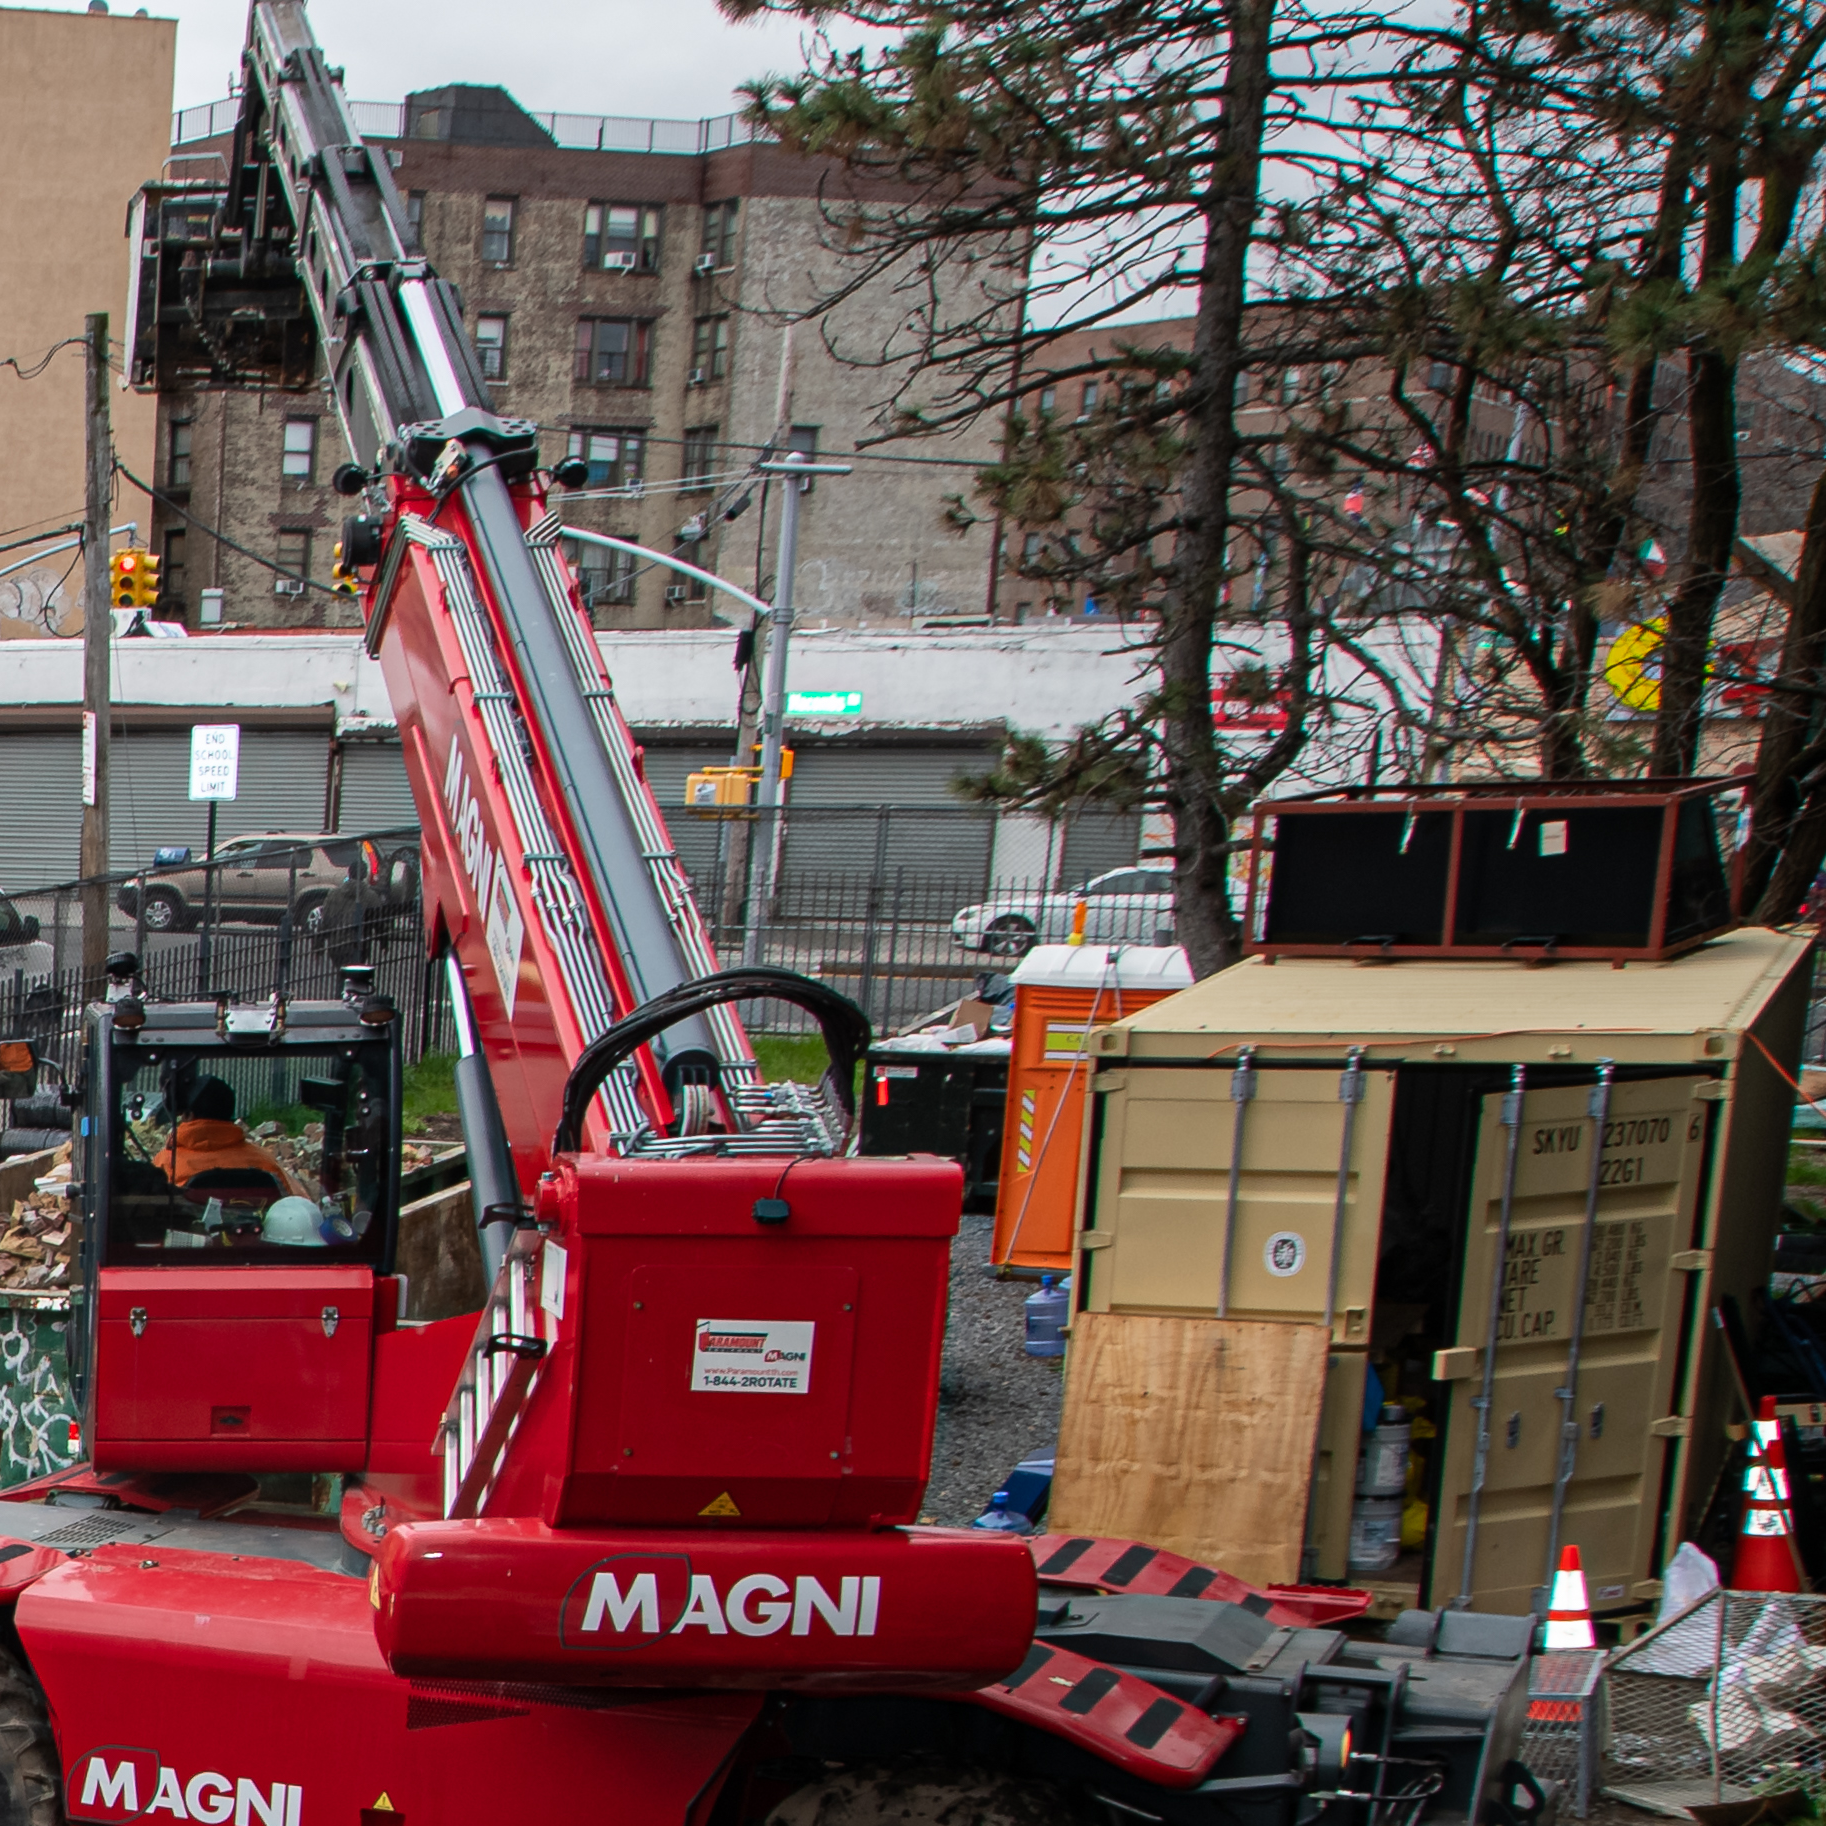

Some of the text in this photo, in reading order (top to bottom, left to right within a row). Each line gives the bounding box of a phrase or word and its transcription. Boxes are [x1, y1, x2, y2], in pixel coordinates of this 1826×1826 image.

[205, 732, 225, 745] END
[194, 749, 237, 761] SCHOOL
[198, 765, 230, 777] SPEED
[200, 781, 225, 793] LIMIT
[444, 733, 494, 925] MAGNI
[1532, 1116, 1700, 1155] SKYU 237070 6
[1599, 1157, 1643, 1186] 22G1
[1503, 1258, 1542, 1285] TARE
[765, 1349, 807, 1362] MAGNI
[703, 1375, 798, 1389] 1-844-2ROTATE
[580, 1571, 881, 1637] MAGNI
